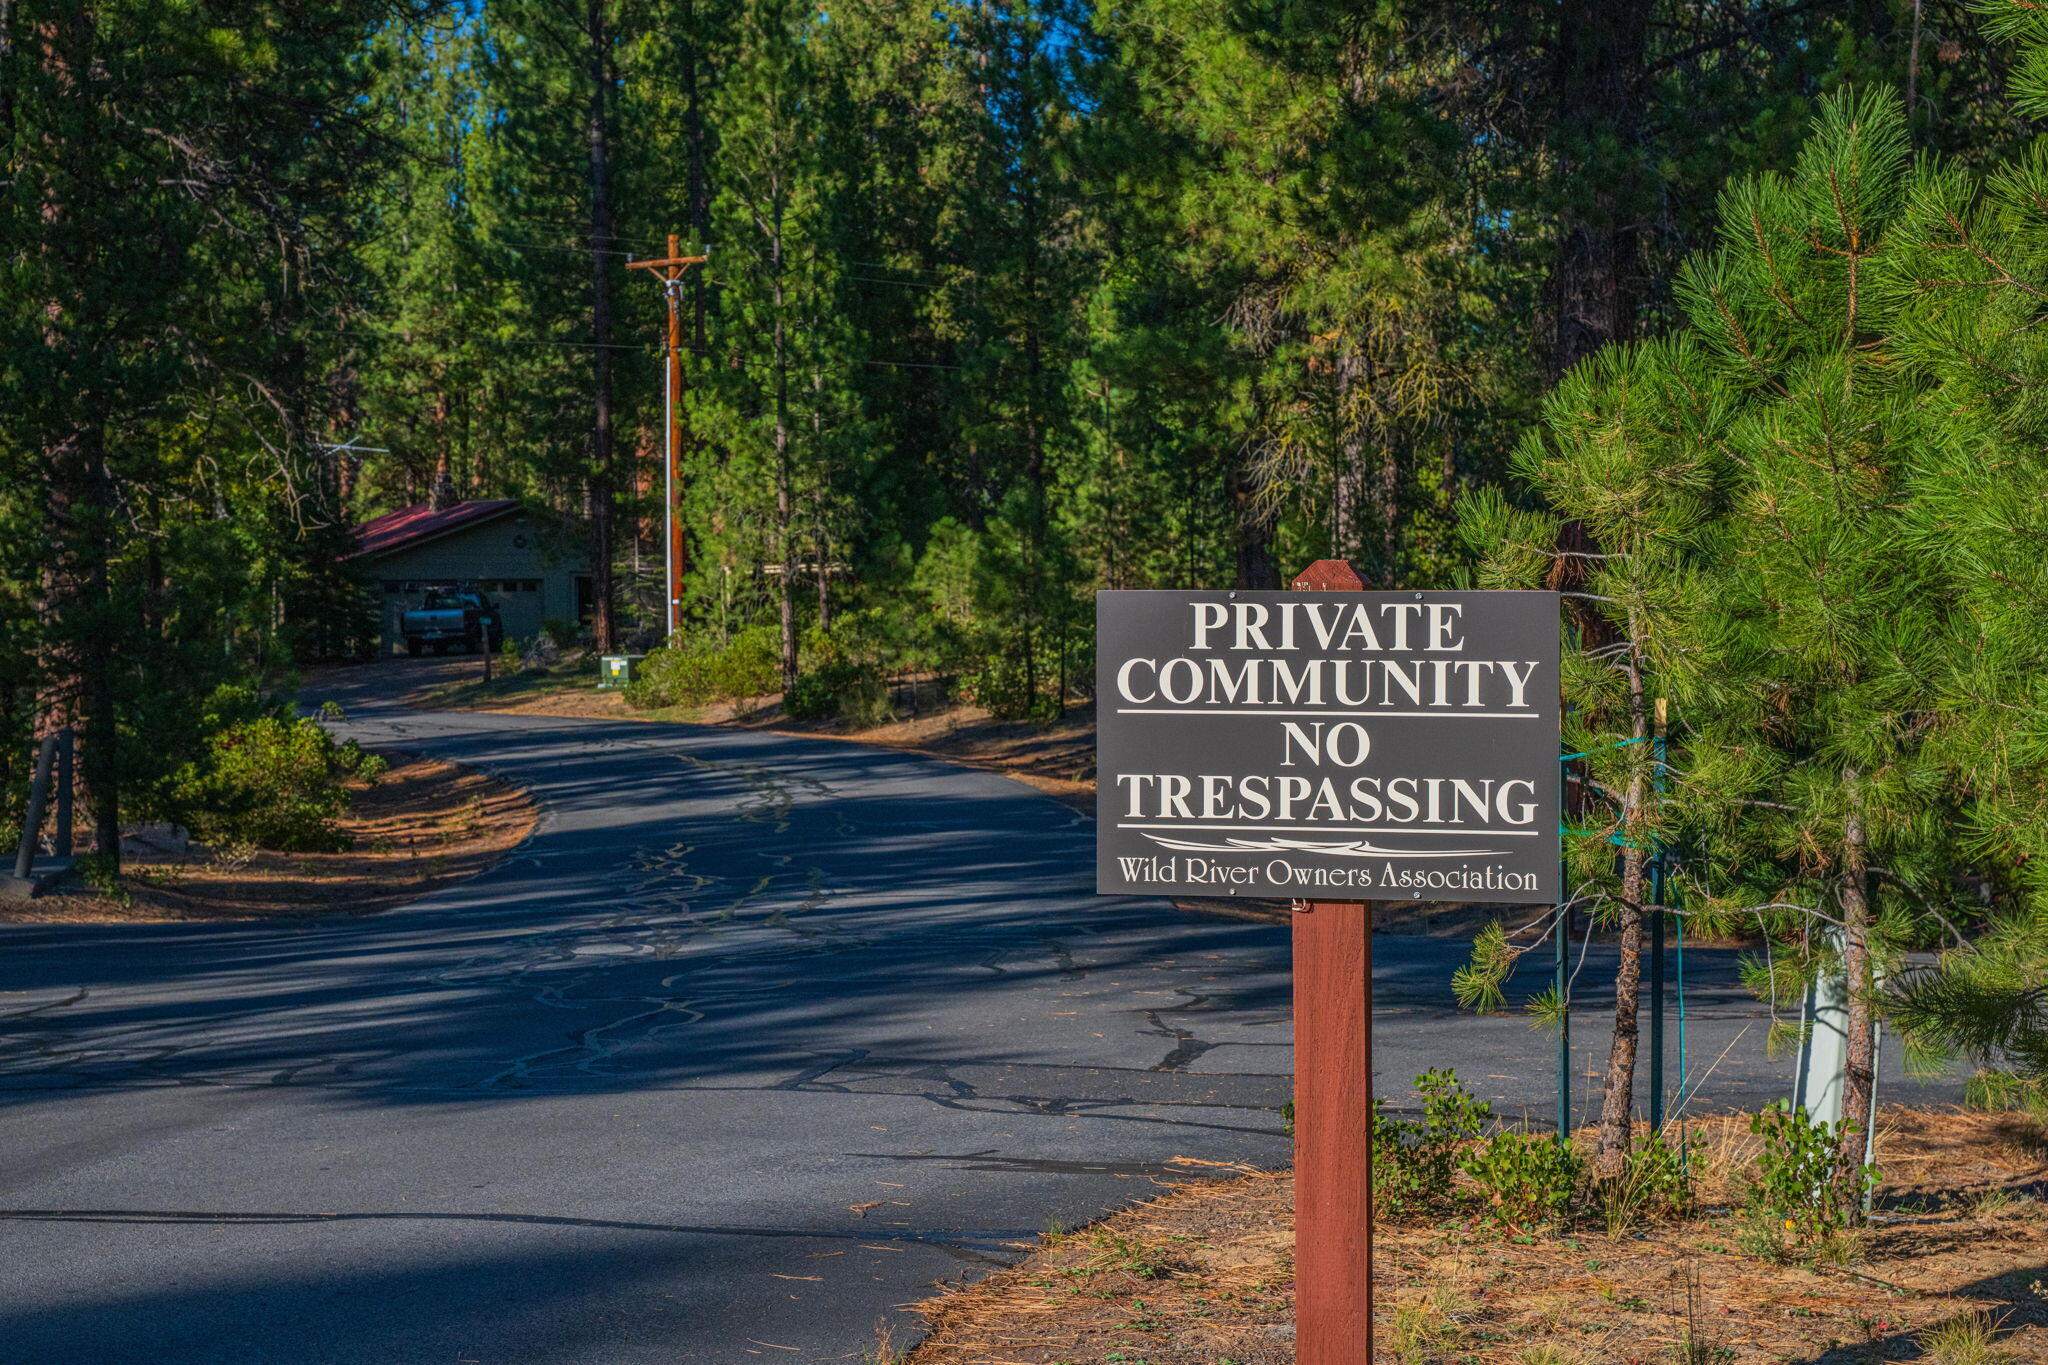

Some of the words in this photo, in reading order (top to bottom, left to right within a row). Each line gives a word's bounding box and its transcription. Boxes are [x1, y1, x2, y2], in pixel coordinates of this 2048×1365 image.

[1188, 602, 1465, 652] PRIVATE
[1116, 657, 1540, 708] COMMUNITY
[1279, 721, 1371, 768] NO
[1116, 773, 1539, 825] TRESPASSING
[1116, 855, 1177, 883] Wild
[1185, 857, 1259, 885] River
[1266, 859, 1372, 887] Owners
[1378, 861, 1539, 891] Association
